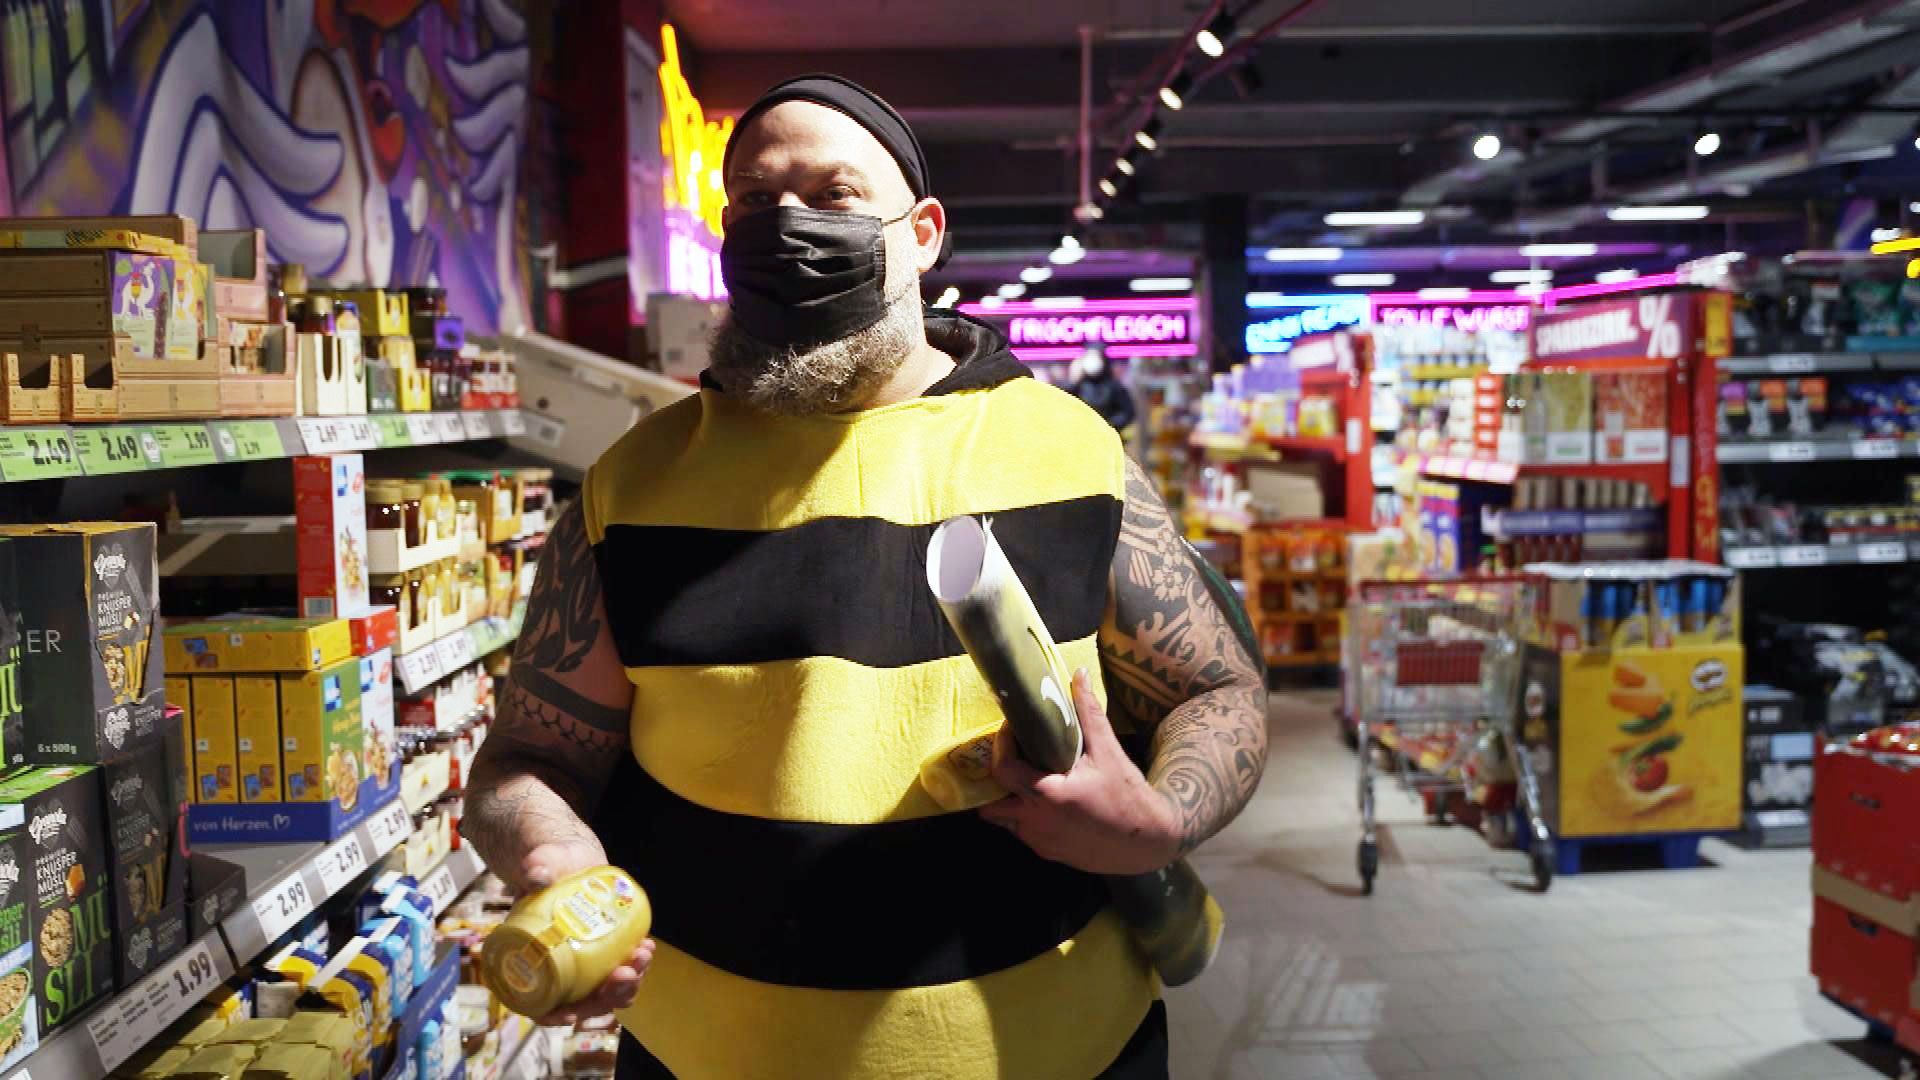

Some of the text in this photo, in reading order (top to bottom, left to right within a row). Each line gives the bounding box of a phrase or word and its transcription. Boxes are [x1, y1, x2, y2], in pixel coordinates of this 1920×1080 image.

[1008, 313, 1188, 345] FRISCHFLEISCH
[1639, 294, 1682, 359] %
[27, 438, 72, 465] 2.49
[101, 435, 138, 461] 2.49
[98, 595, 132, 612] KNUSPER
[193, 820, 218, 831] von
[37, 851, 76, 881] KNUSPER
[277, 880, 305, 918] 2.99
[172, 951, 212, 998] 1.99
